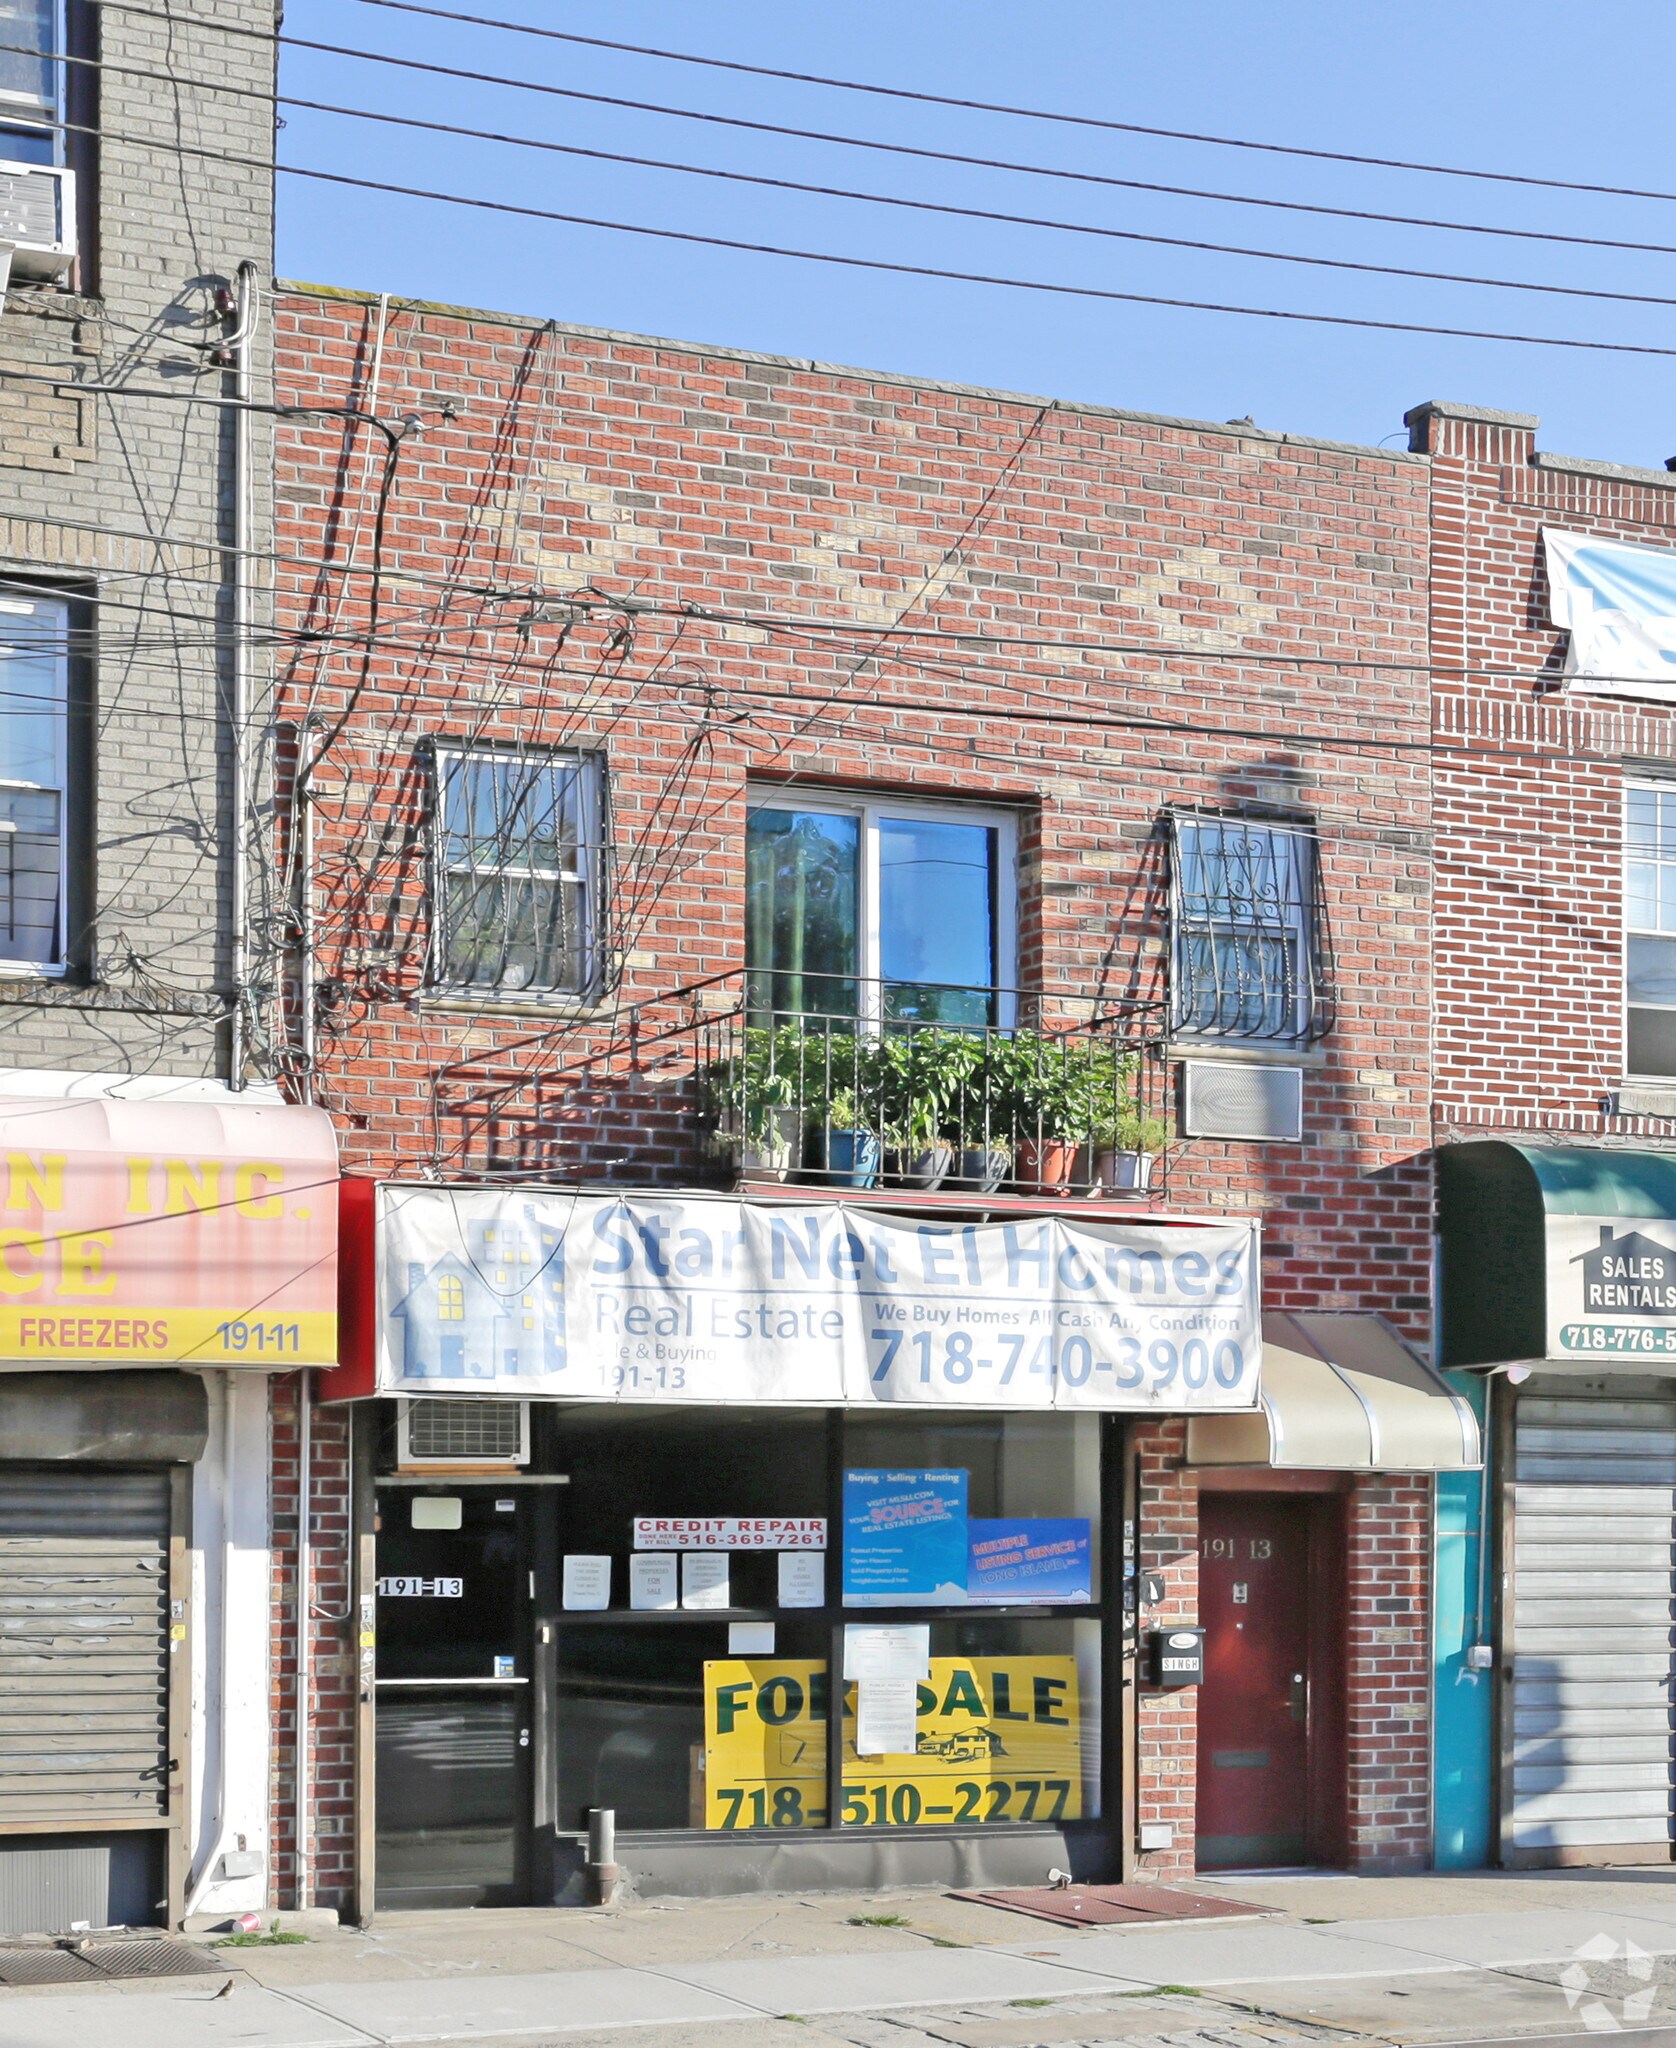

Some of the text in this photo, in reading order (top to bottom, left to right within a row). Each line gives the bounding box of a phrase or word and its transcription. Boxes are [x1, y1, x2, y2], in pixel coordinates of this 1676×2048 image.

[125, 1157, 312, 1220] INC.
[0, 1228, 117, 1296] CE
[591, 1206, 1244, 1297] Star Net El Homes
[1602, 1256, 1664, 1280] SALES
[1590, 1284, 1676, 1308] RENTALS
[596, 1294, 844, 1341] Real Estate
[875, 1303, 907, 1322] We
[913, 1304, 951, 1325] Buy
[956, 1306, 1020, 1326] Homes
[1029, 1309, 1052, 1326] All
[1149, 1312, 1240, 1332] Condition
[19, 1318, 299, 1351] FREEZERS 191-11
[636, 1343, 649, 1360] &
[655, 1343, 717, 1364] Buying
[871, 1328, 1244, 1390] 718-740-3900
[597, 1364, 686, 1389] 191-13
[848, 1473, 960, 1485] Buying Selling Renting
[870, 1498, 945, 1525] SOURCE
[638, 1520, 824, 1532] CREDIT REPAIR
[678, 1534, 825, 1545] 516-369-7261
[972, 1533, 1030, 1556] MULTIPLE
[1201, 1538, 1272, 1560] 191 13
[975, 1551, 1023, 1571] LISTING
[1024, 1539, 1077, 1561] SERVICE
[979, 1566, 1019, 1585] LONG
[1163, 1658, 1199, 1671] SINGH
